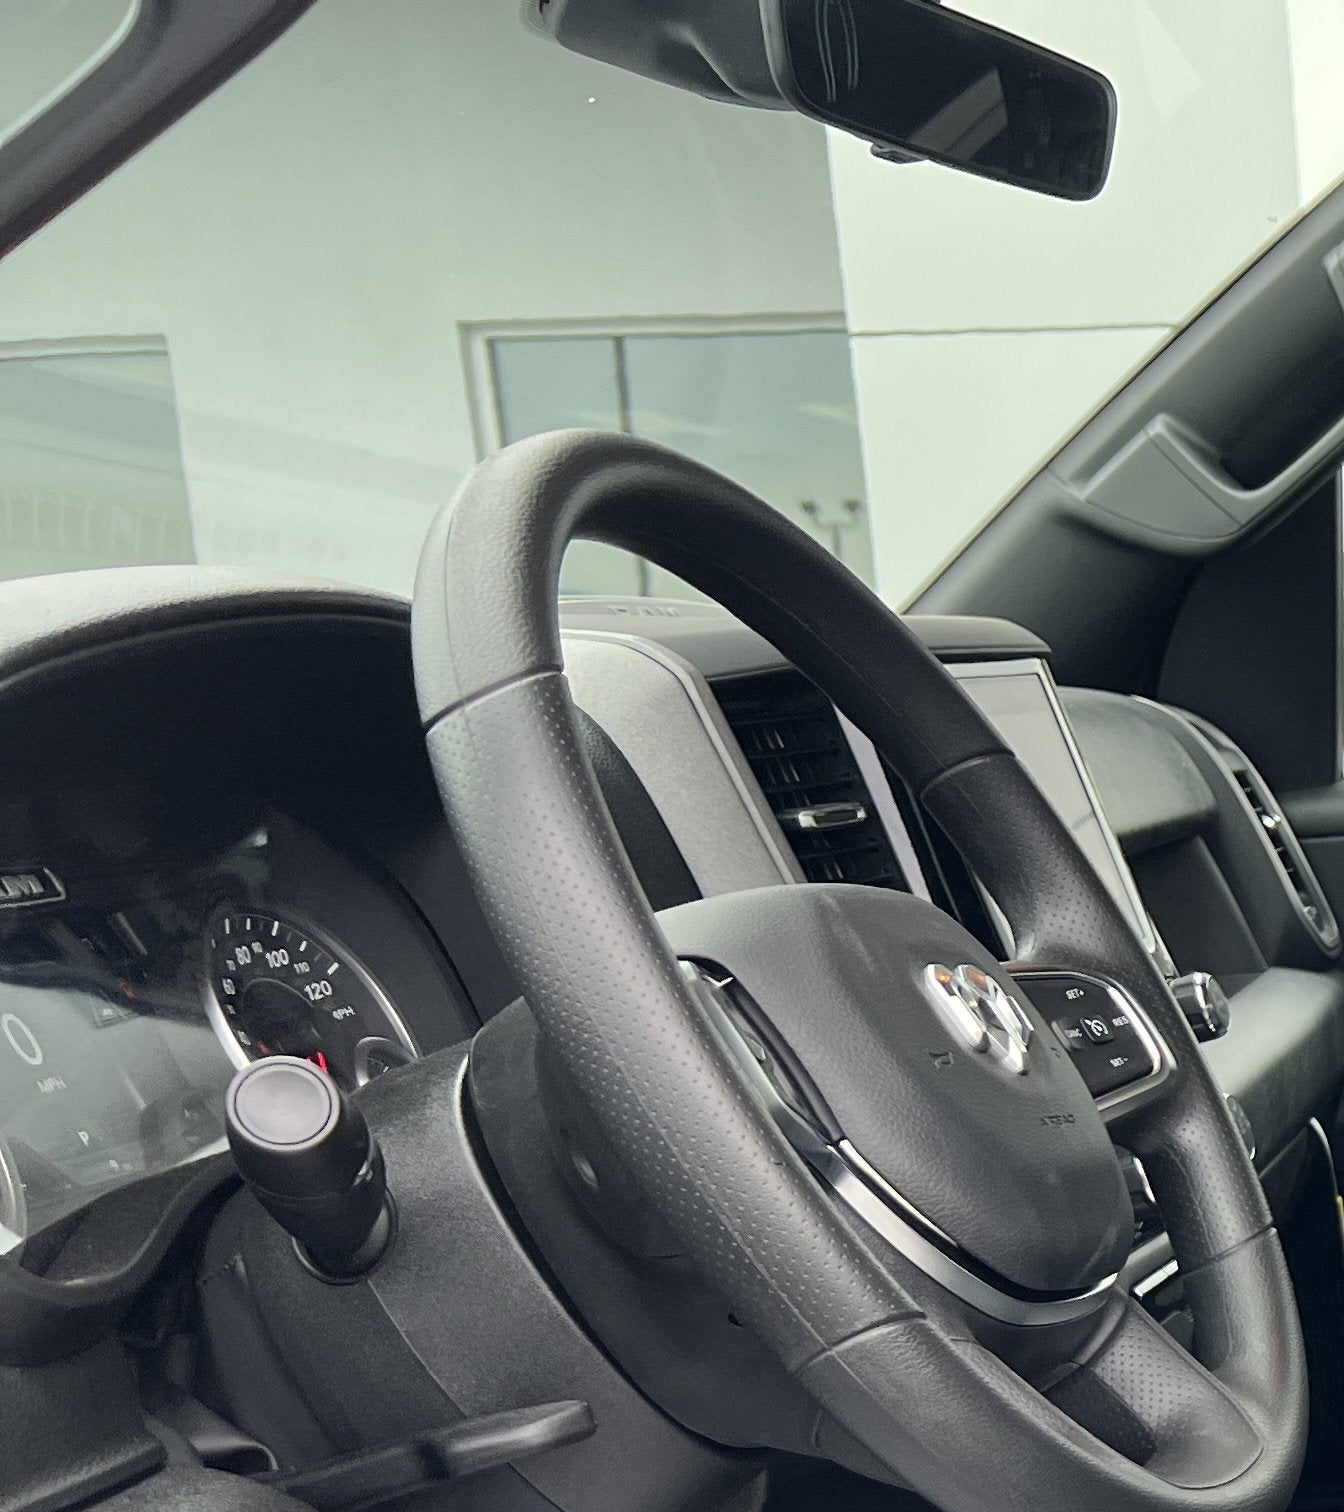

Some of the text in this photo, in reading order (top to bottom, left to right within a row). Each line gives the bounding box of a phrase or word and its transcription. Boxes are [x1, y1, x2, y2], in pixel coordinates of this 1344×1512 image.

[266, 949, 289, 968] 100
[294, 962, 310, 974] 110
[304, 980, 332, 1000] 120
[36, 1077, 67, 1093] MPH
[78, 1131, 89, 1145] P
